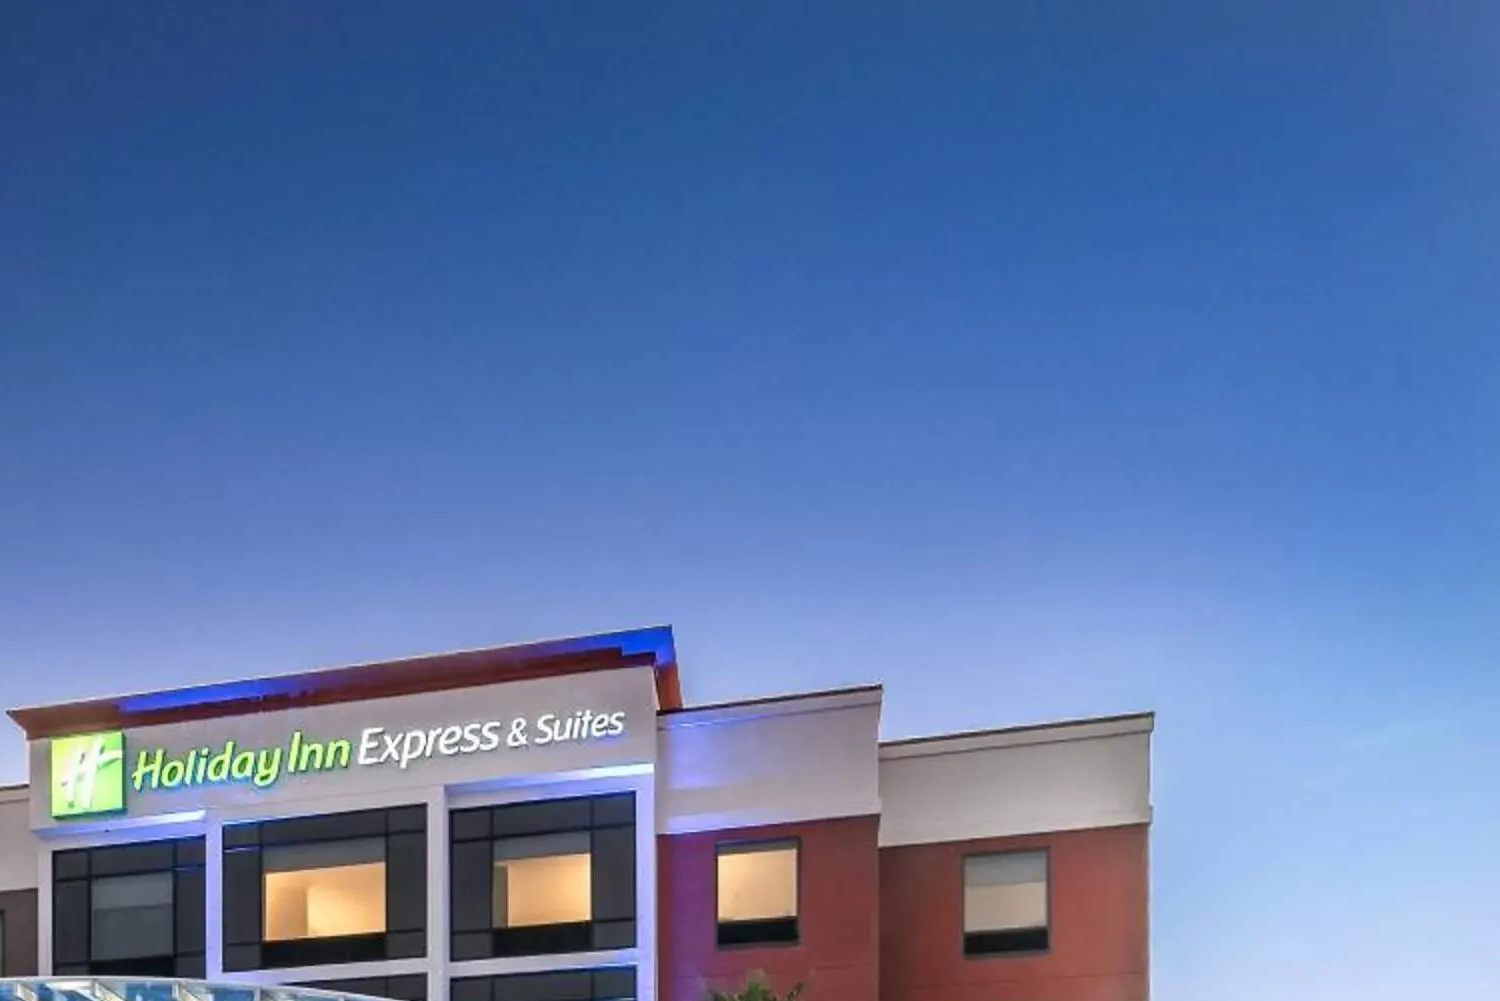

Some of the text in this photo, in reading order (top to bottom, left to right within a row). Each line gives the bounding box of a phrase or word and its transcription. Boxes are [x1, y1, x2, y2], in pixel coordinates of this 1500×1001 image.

[132, 711, 626, 789] Holiday Inn Express & Suites
